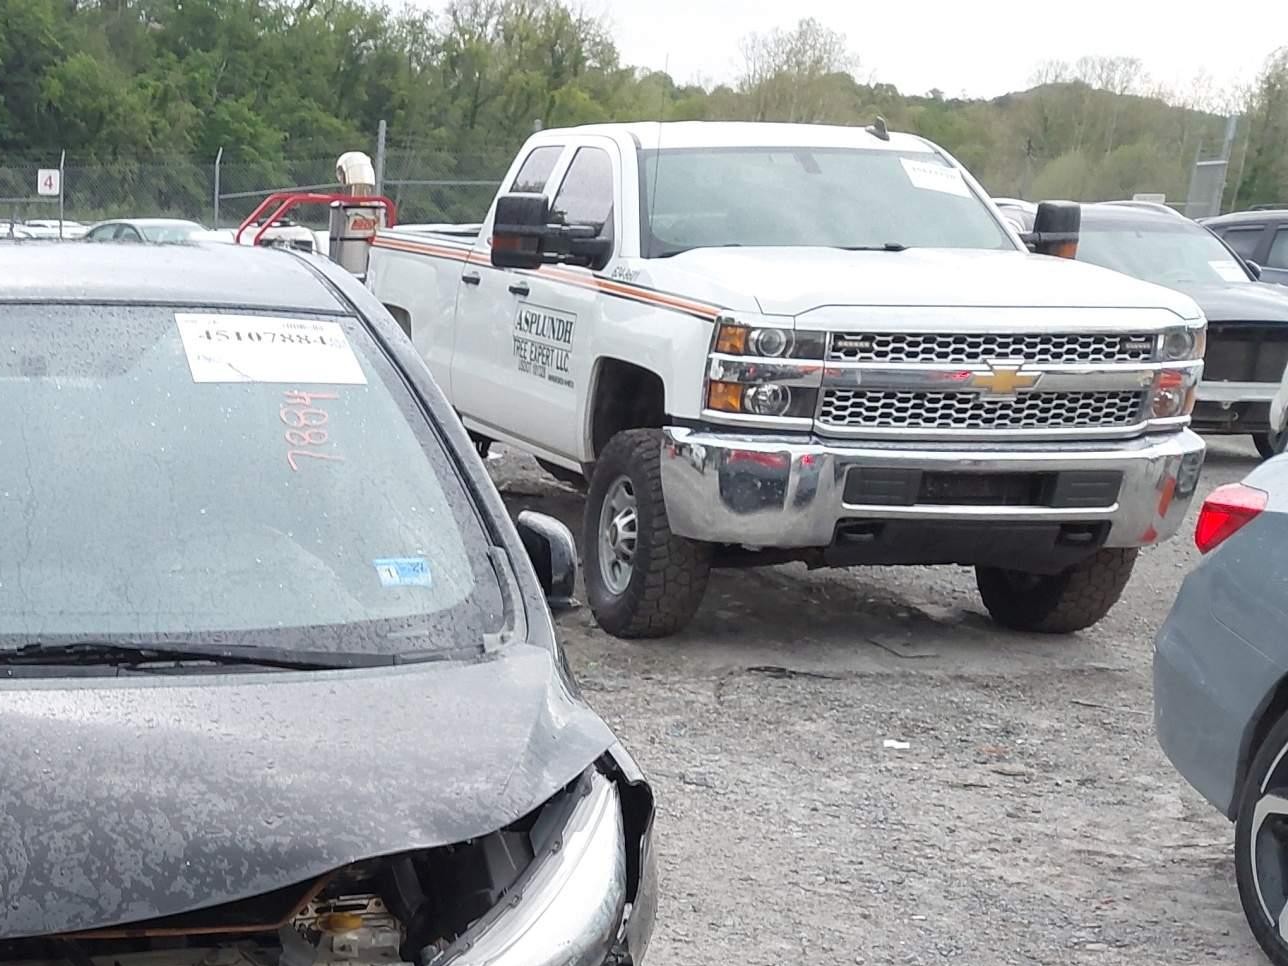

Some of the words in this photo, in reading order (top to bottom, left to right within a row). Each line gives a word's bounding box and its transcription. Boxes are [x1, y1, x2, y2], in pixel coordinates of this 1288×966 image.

[43, 175, 53, 190] 4
[515, 308, 574, 345] ASPLUNDH
[513, 337, 528, 360] TREE
[530, 343, 555, 368] EXPERT
[556, 350, 570, 373] LLC
[279, 391, 345, 472] 7884
